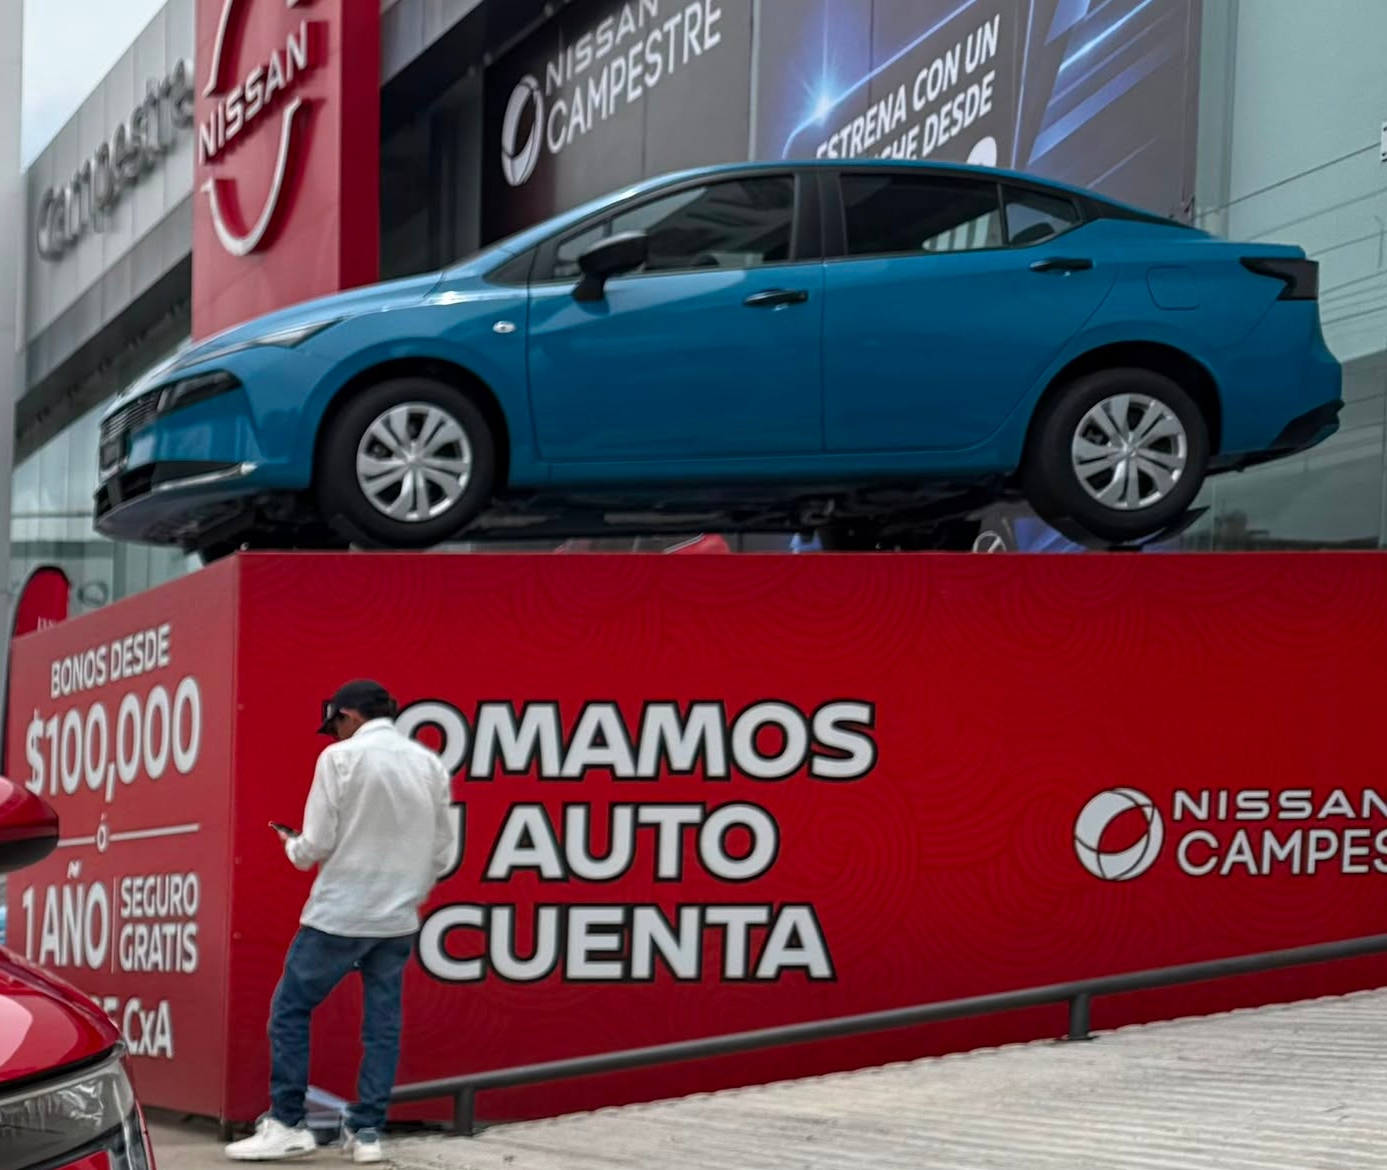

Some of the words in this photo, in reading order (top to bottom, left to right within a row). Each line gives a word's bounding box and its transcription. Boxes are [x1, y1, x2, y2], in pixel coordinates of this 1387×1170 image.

[545, 0, 659, 97] NISSAN
[546, 0, 722, 154] CAMPESTRE
[912, 42, 961, 112] CON
[965, 13, 1000, 74] UN
[198, 19, 308, 166] NISSAN
[922, 69, 996, 157] DESDE
[50, 645, 107, 699] BONOS
[110, 622, 171, 682] DESDE
[25, 675, 201, 804] $100,000
[395, 702, 877, 780] OMAMOS
[486, 804, 777, 880] AUTO
[1173, 789, 1387, 821] NISSAN
[22, 885, 35, 961] 1
[39, 860, 109, 970] AÑO
[120, 872, 199, 918] SEGURO
[119, 921, 199, 974] GRATIS
[418, 905, 833, 980] CUENTA
[122, 997, 174, 1059] CxA
